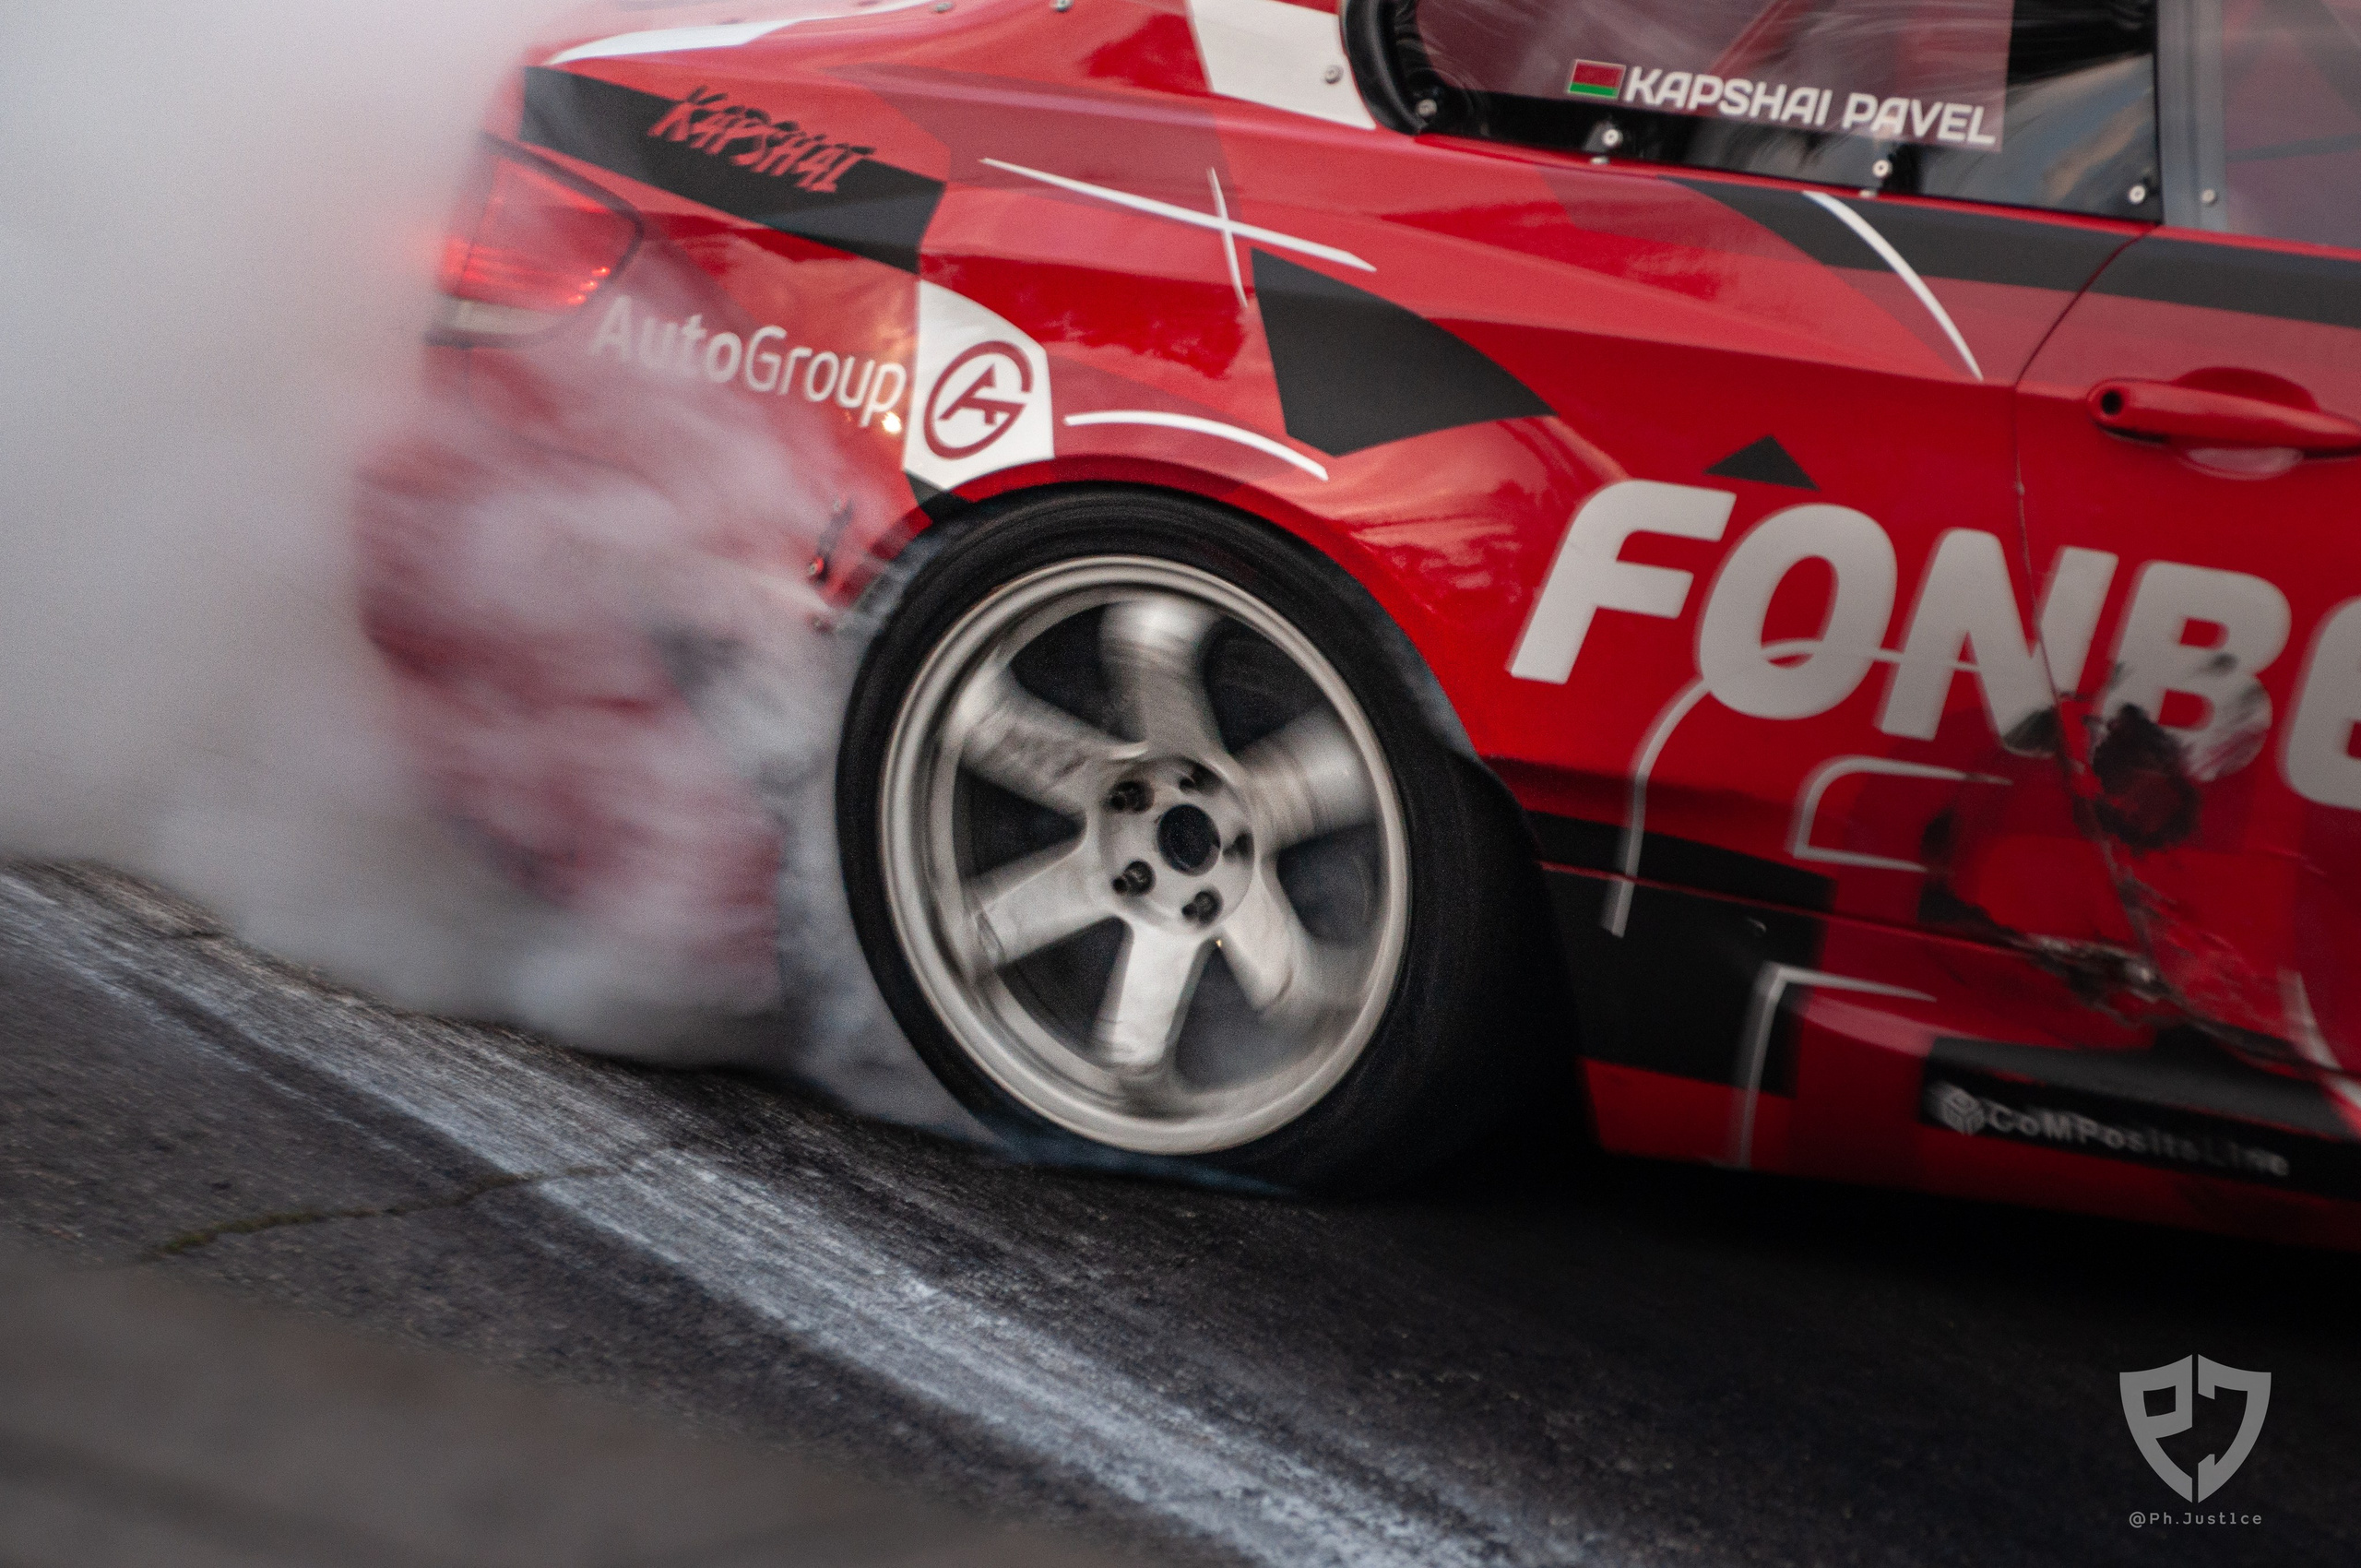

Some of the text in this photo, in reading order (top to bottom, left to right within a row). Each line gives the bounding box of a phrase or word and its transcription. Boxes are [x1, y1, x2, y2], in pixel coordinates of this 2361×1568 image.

[1623, 65, 1997, 146] KAPSHAI PAVEL
[588, 294, 908, 428] AutoGroup
